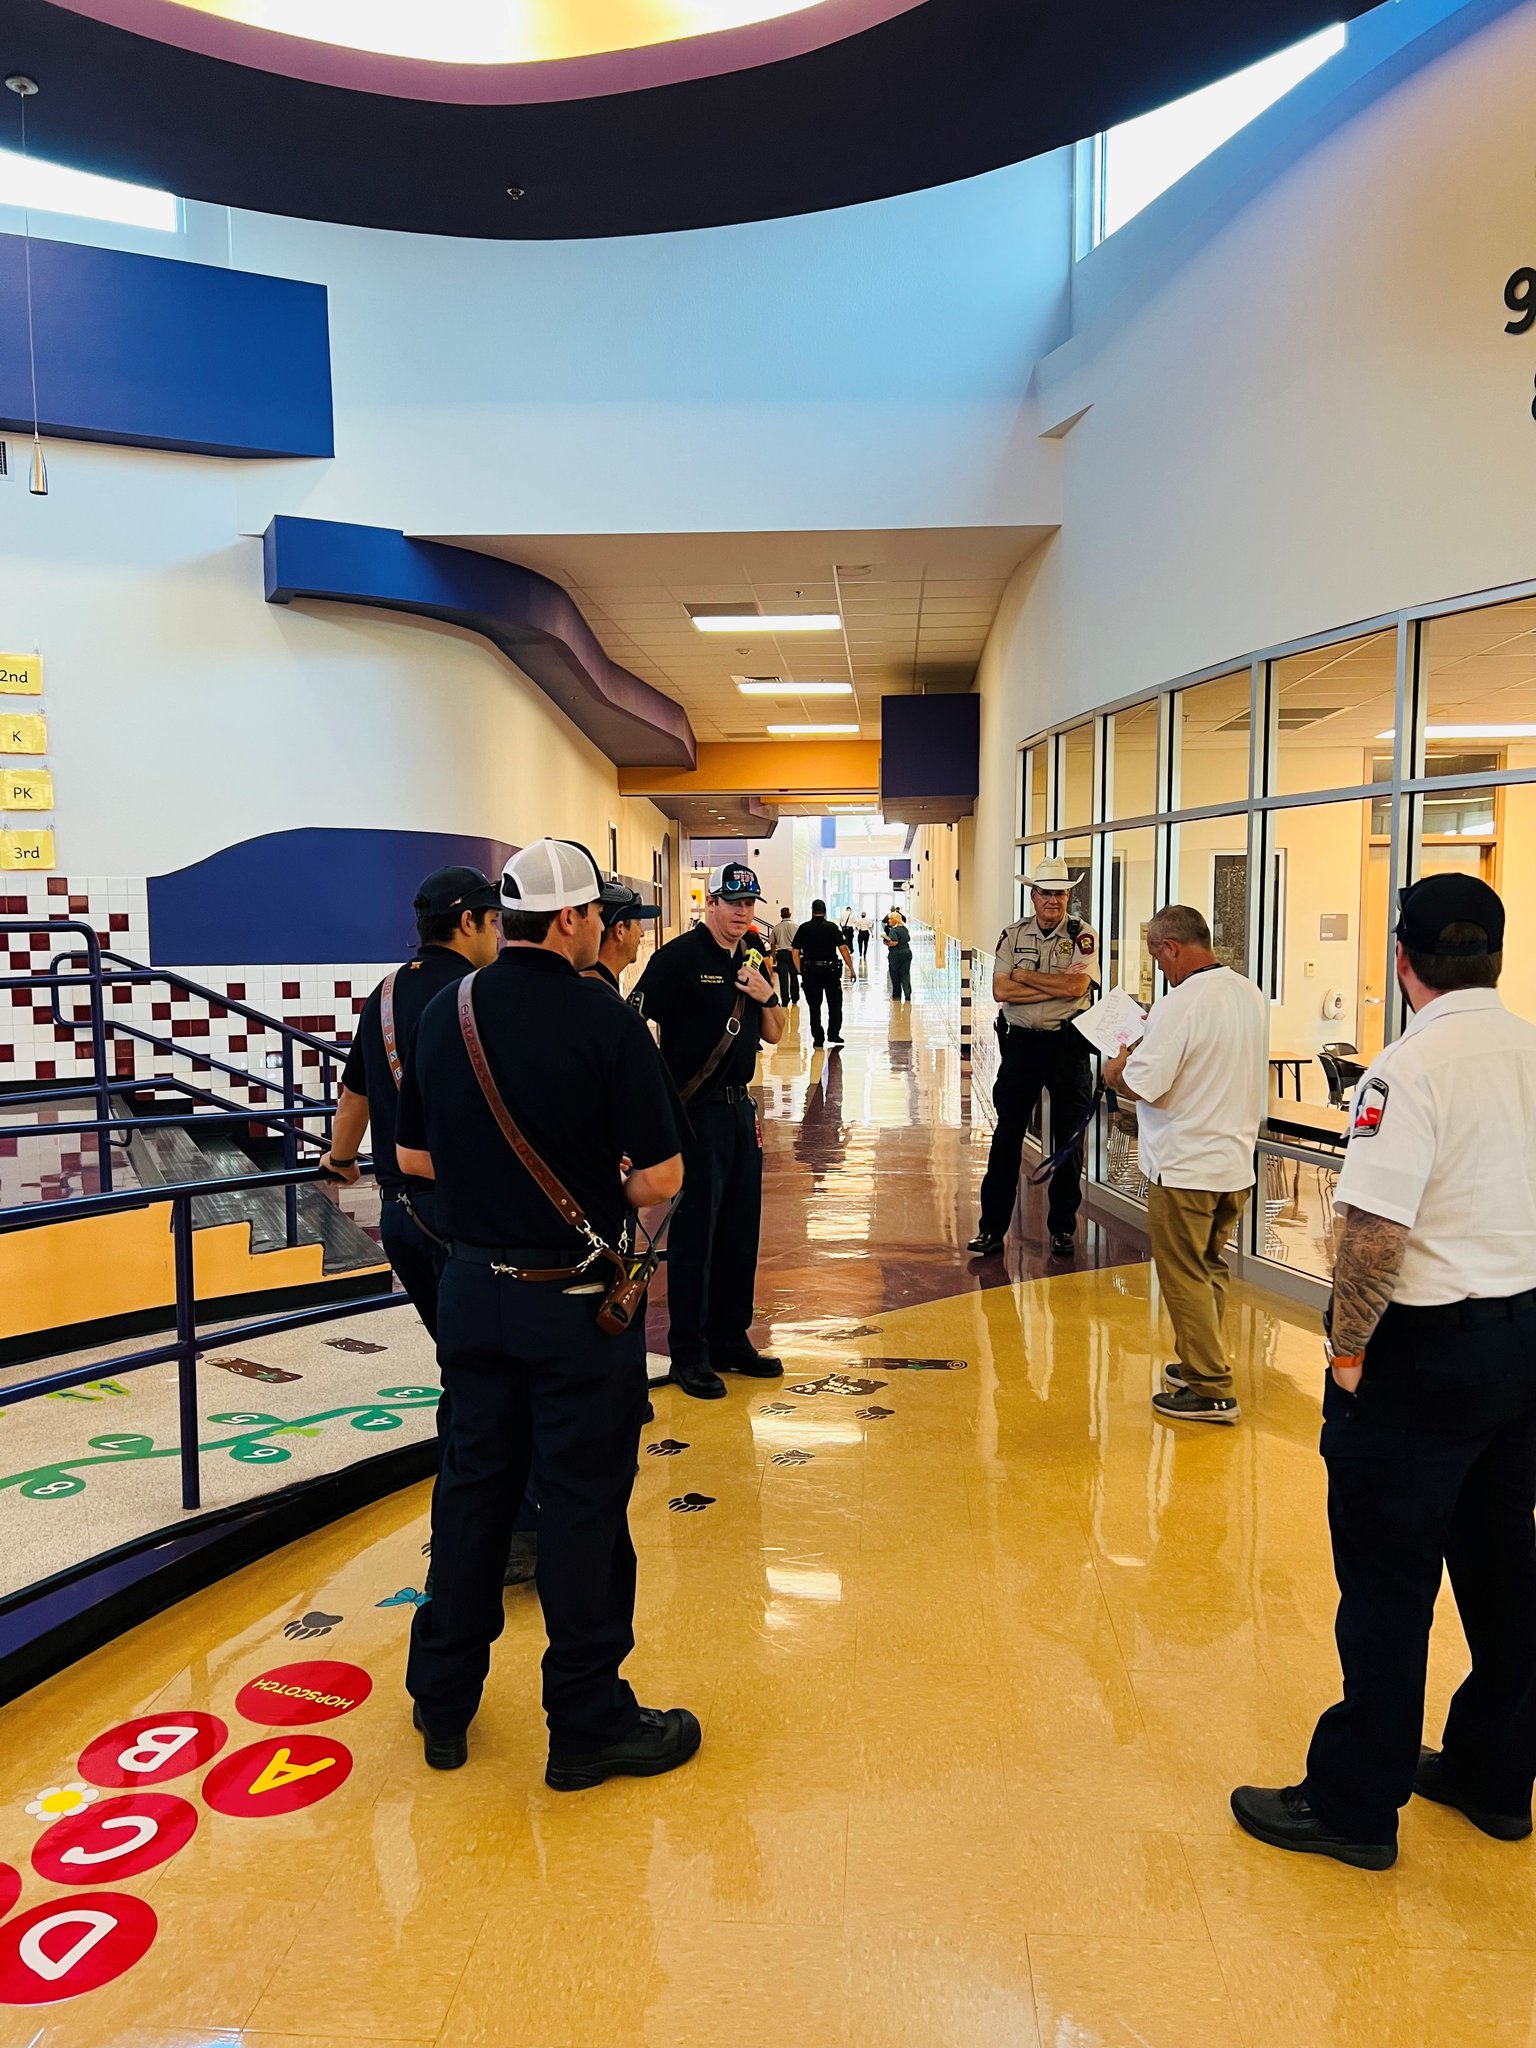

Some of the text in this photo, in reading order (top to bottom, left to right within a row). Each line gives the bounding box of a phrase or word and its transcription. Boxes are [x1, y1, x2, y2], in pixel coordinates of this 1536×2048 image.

[0, 670, 29, 683] 2nd
[12, 730, 22, 742] K
[13, 787, 33, 799] PK
[14, 847, 40, 859] 3rd
[394, 1388, 424, 1398] 3
[222, 1414, 259, 1425] 5
[362, 1416, 394, 1427] 4
[243, 1448, 280, 1459] 6
[33, 1481, 75, 1495] 8
[252, 1678, 355, 1710] HOPSCOTCH
[117, 1726, 199, 1772] B
[248, 1747, 337, 1795] A
[60, 1815, 159, 1865] C
[19, 1909, 118, 1981] D
